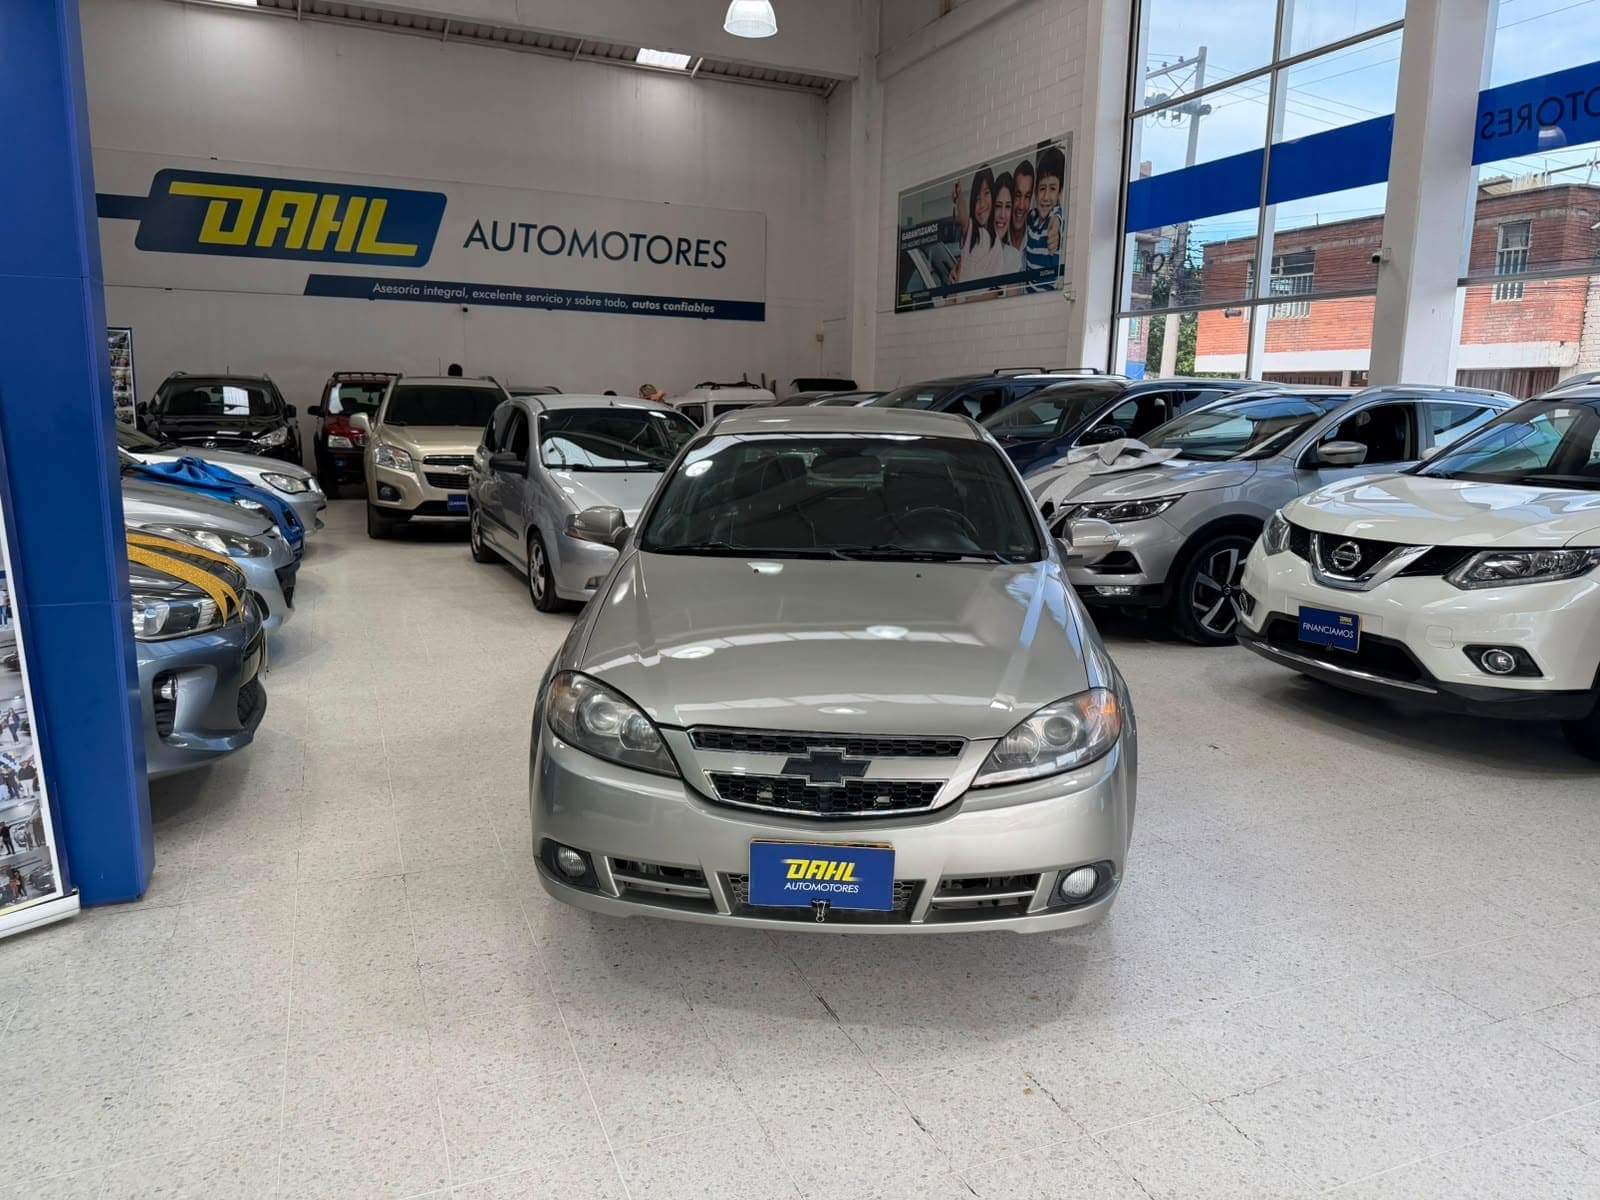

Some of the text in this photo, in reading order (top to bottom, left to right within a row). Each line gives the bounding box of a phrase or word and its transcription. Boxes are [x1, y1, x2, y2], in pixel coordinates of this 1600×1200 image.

[168, 181, 418, 256] DAHL
[463, 218, 728, 269] AUTOMOTORES
[372, 282, 715, 313] Asesoría integral, excelente servicio y sobre todo, autos confiables
[1302, 622, 1354, 639] FINANCIAMOS
[780, 858, 863, 882] DAHL
[784, 882, 859, 893] AUTOMOTORES
